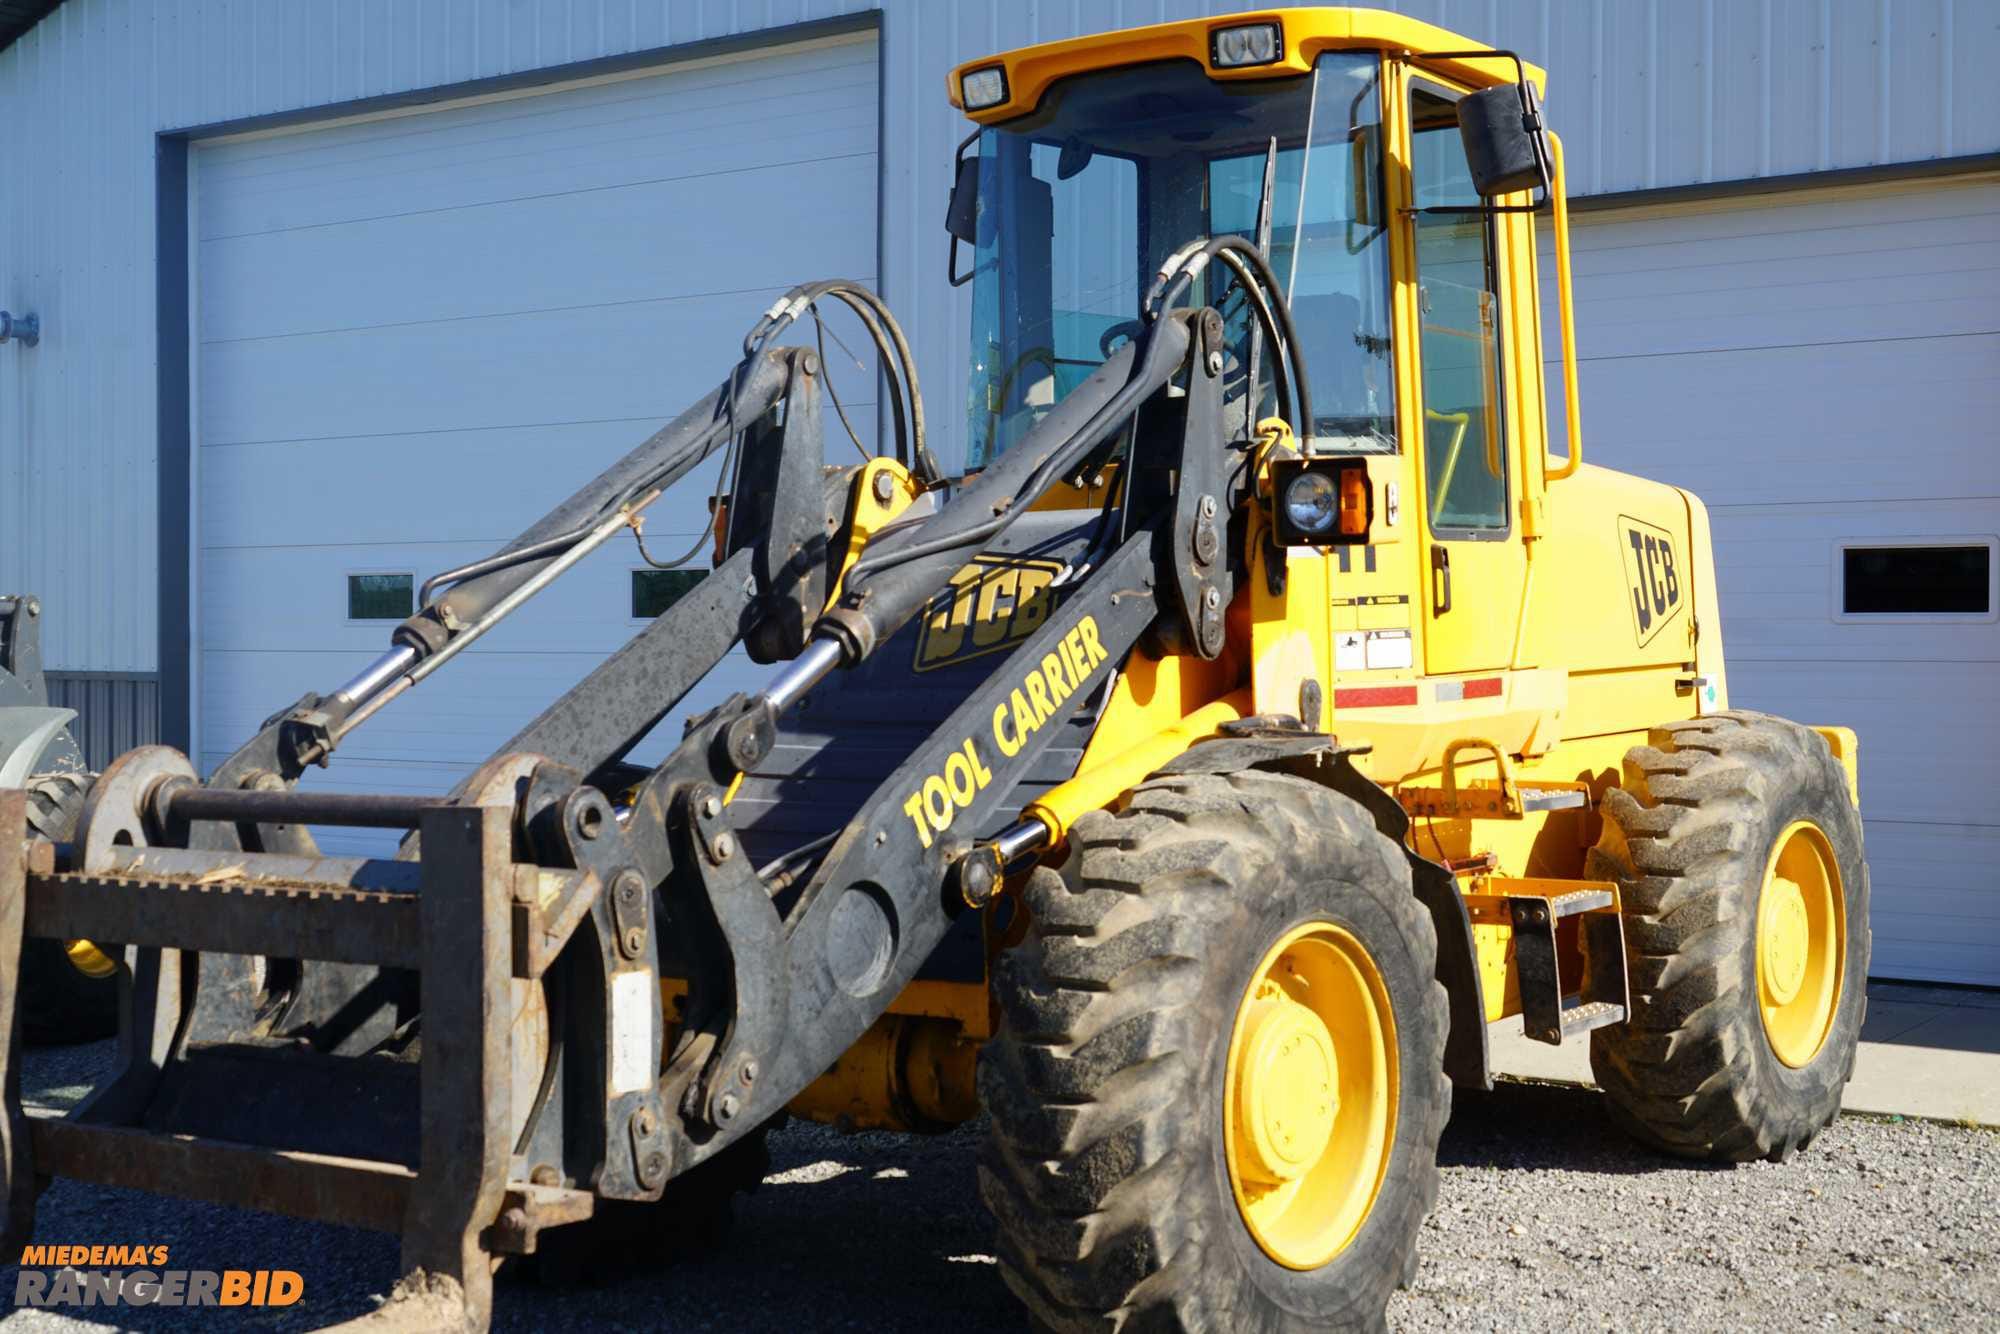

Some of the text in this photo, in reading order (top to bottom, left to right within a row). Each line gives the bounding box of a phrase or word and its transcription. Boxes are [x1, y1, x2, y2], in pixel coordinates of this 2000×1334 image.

[922, 563, 1056, 663] JCB
[1628, 529, 1679, 635] JCB
[903, 614, 1109, 849] TOOL CARRIER
